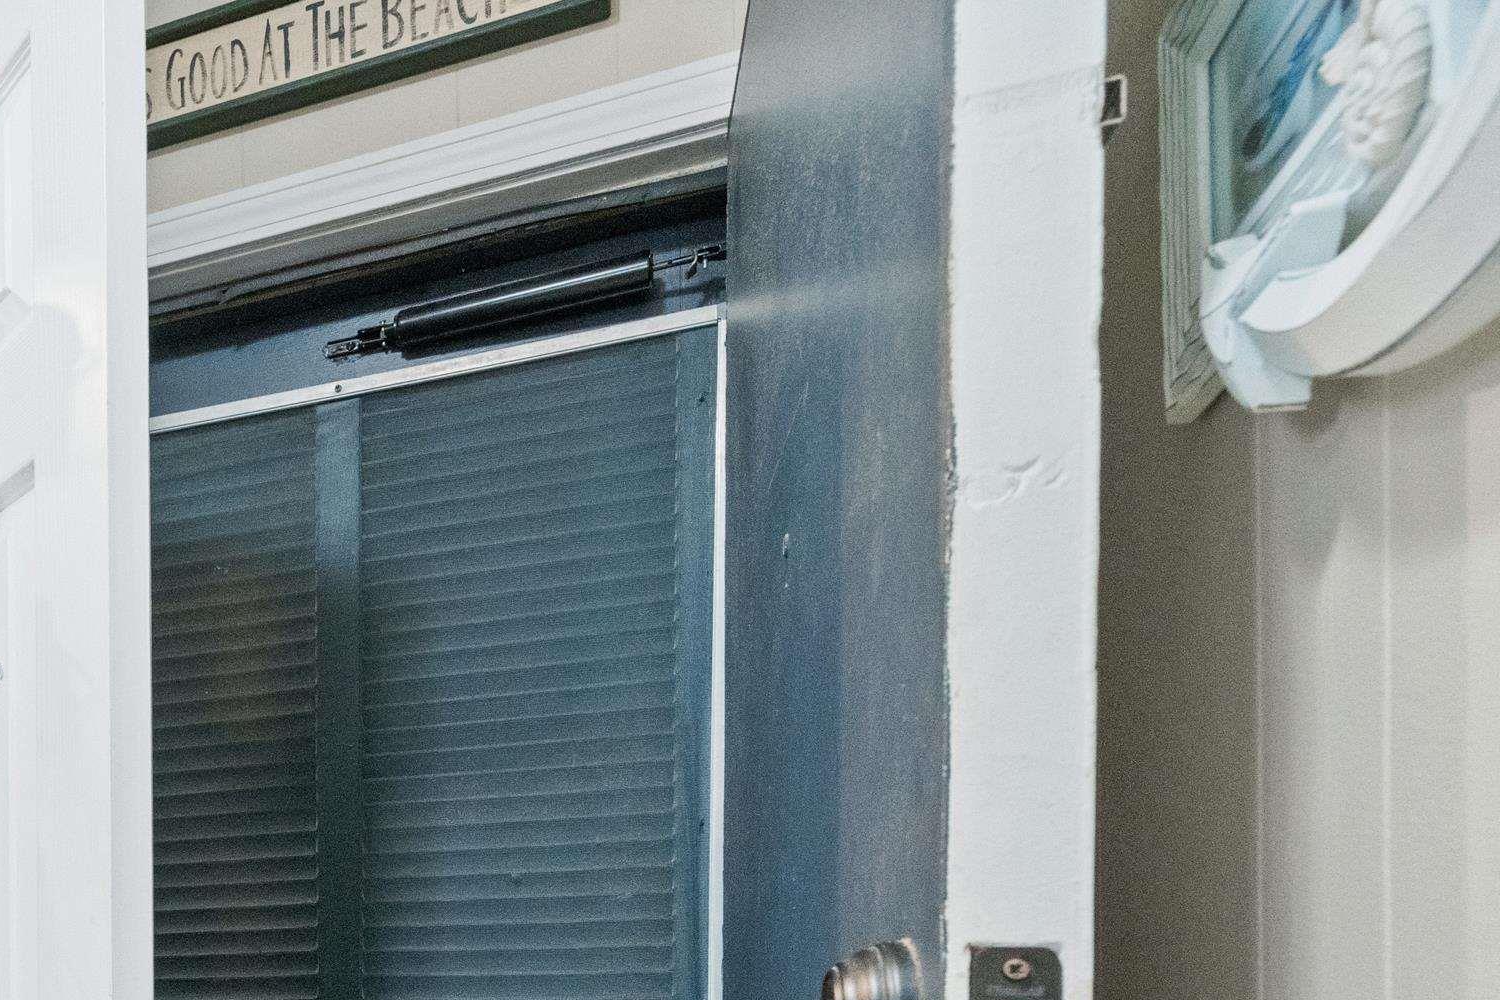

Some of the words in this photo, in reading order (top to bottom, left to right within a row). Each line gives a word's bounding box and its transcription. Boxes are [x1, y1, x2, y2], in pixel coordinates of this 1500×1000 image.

[165, 38, 249, 110] GOOD
[258, 18, 296, 86] AT
[305, 0, 368, 71] THE
